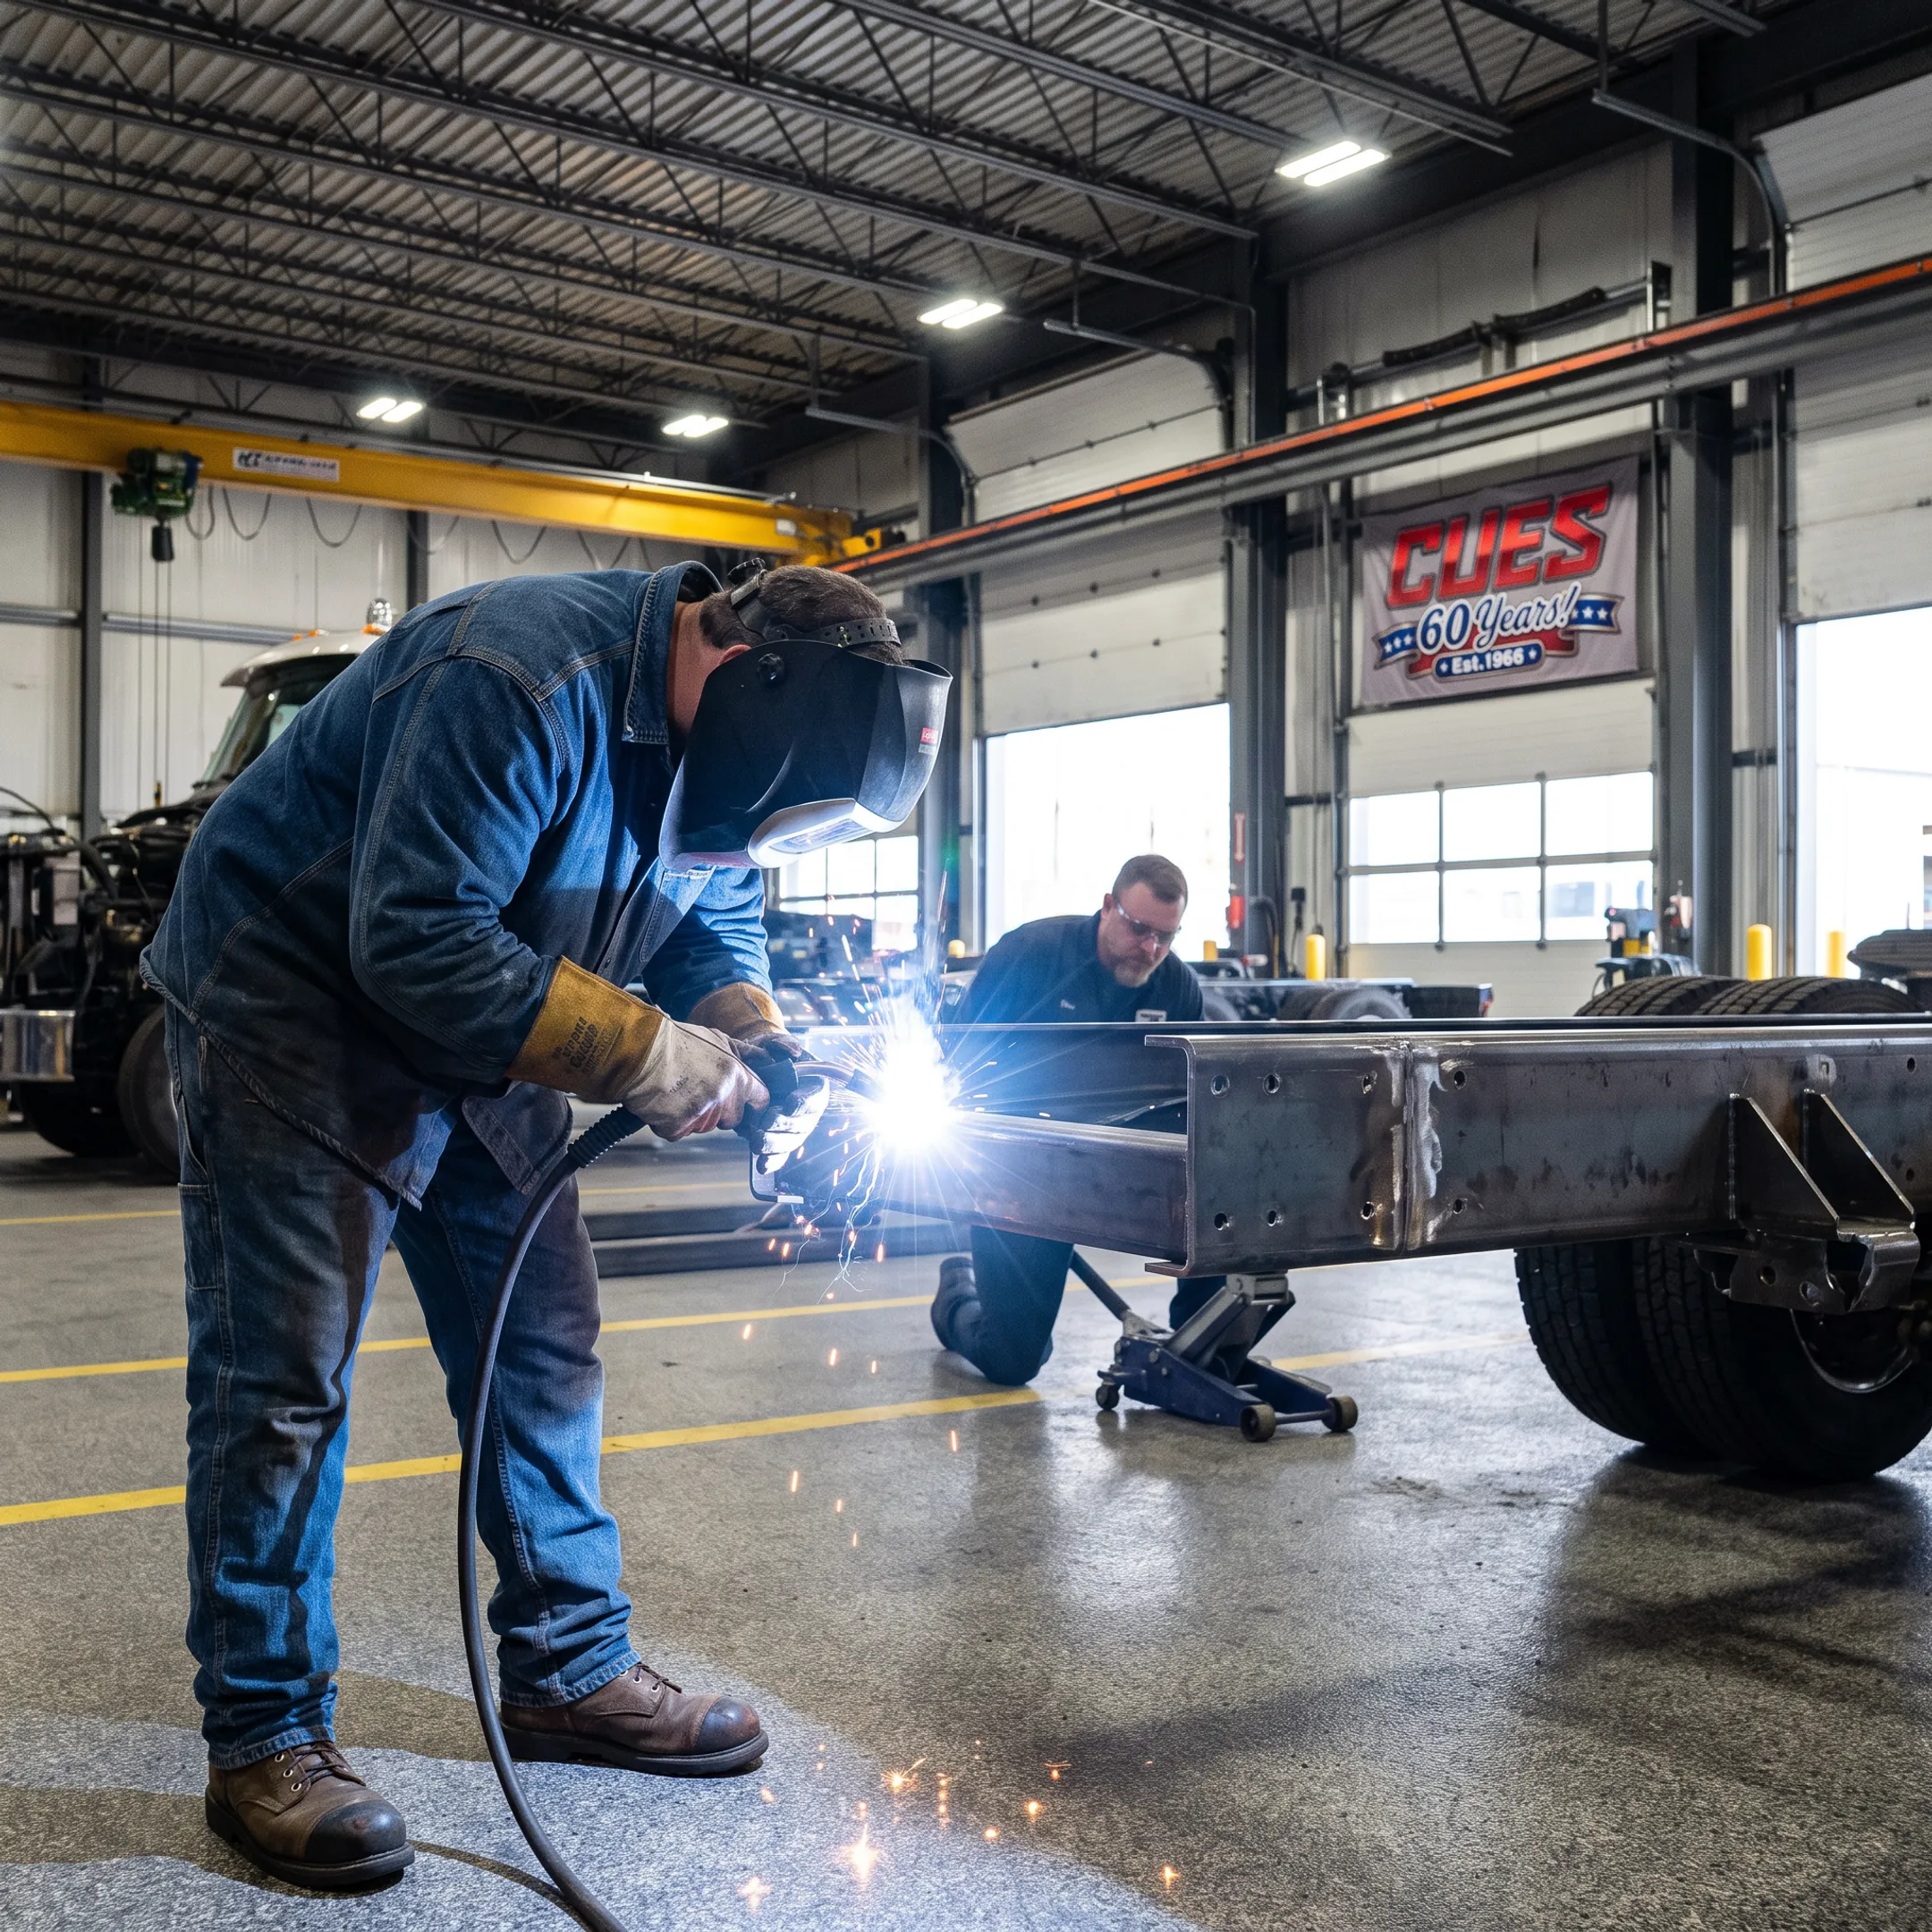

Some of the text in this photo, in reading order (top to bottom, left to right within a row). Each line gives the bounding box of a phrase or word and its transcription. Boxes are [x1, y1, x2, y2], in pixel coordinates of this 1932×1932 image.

[1386, 485, 1611, 609] CUES
[1419, 583, 1580, 653] 60 Years!
